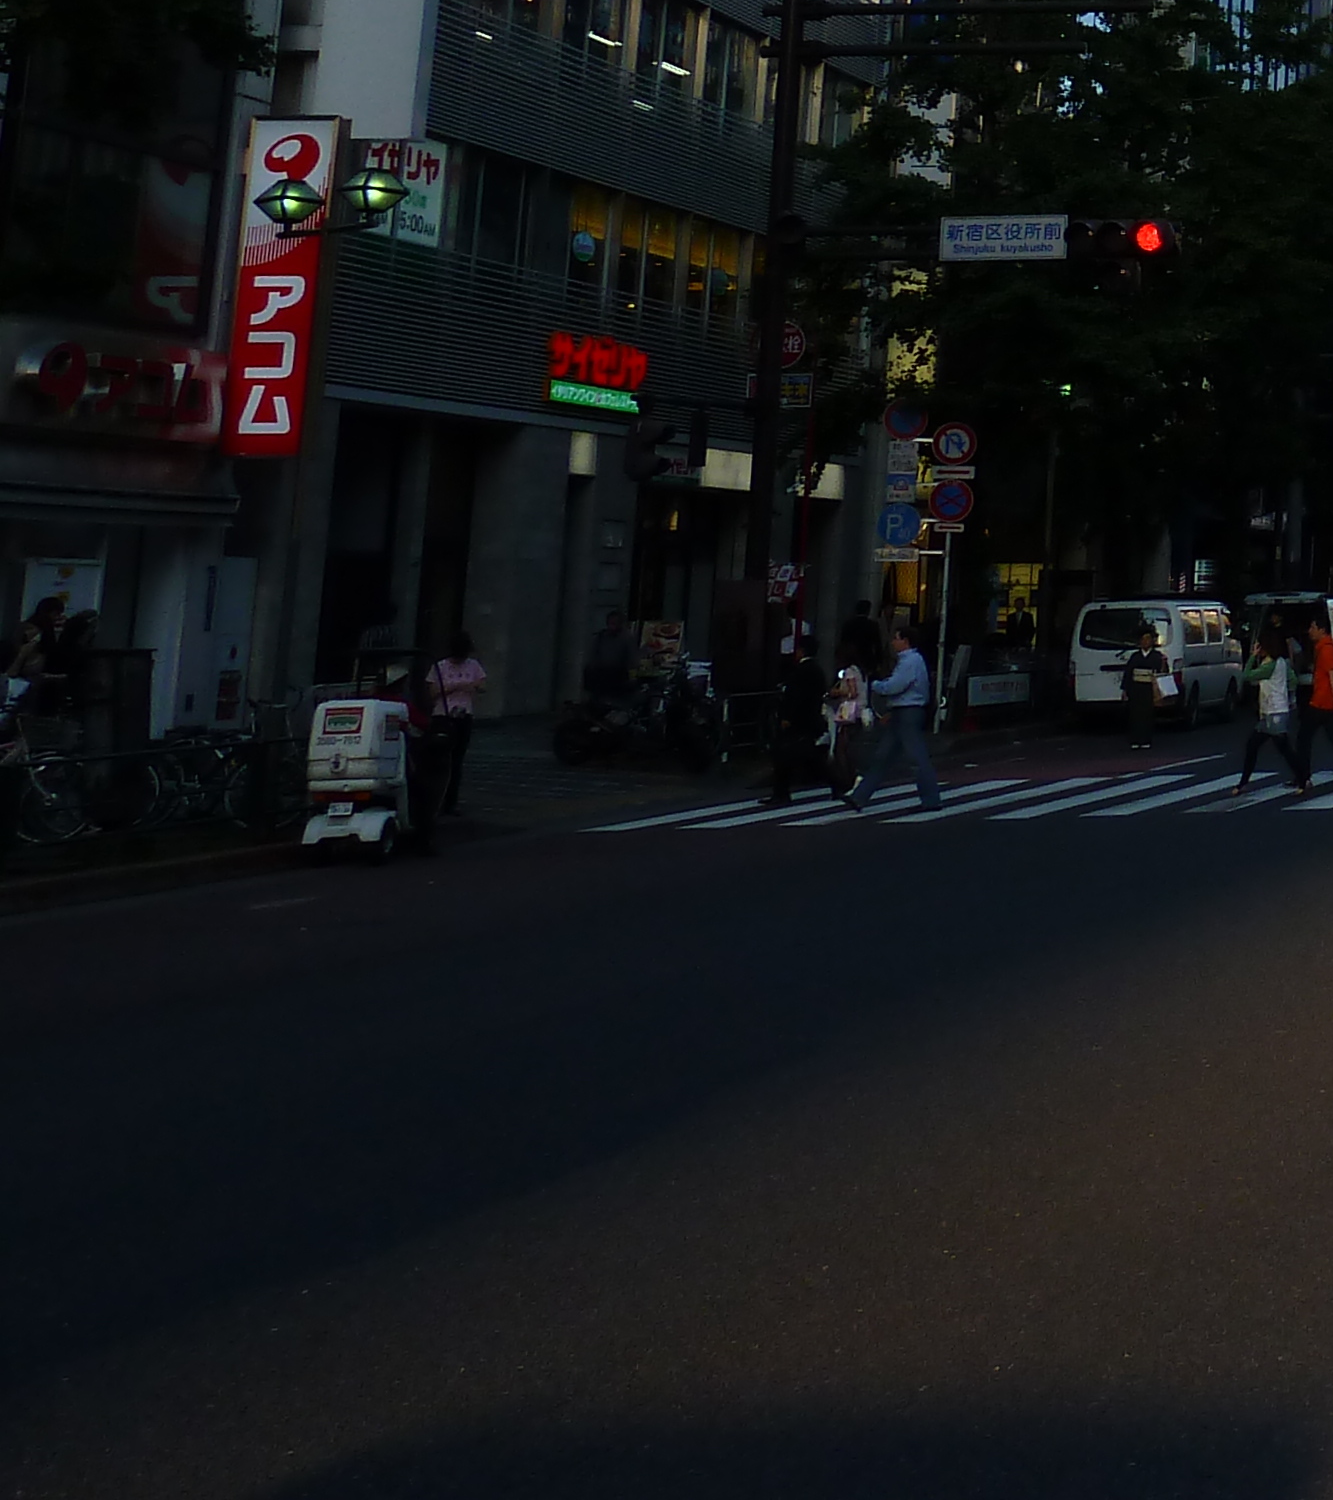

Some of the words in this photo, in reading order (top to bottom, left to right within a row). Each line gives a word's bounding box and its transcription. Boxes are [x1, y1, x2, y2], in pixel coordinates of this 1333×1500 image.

[946, 222, 1062, 242] 新宿区役所前
[953, 243, 996, 255] Shinjuku
[1000, 242, 1054, 254] kuyakusho
[237, 274, 307, 437] アコム
